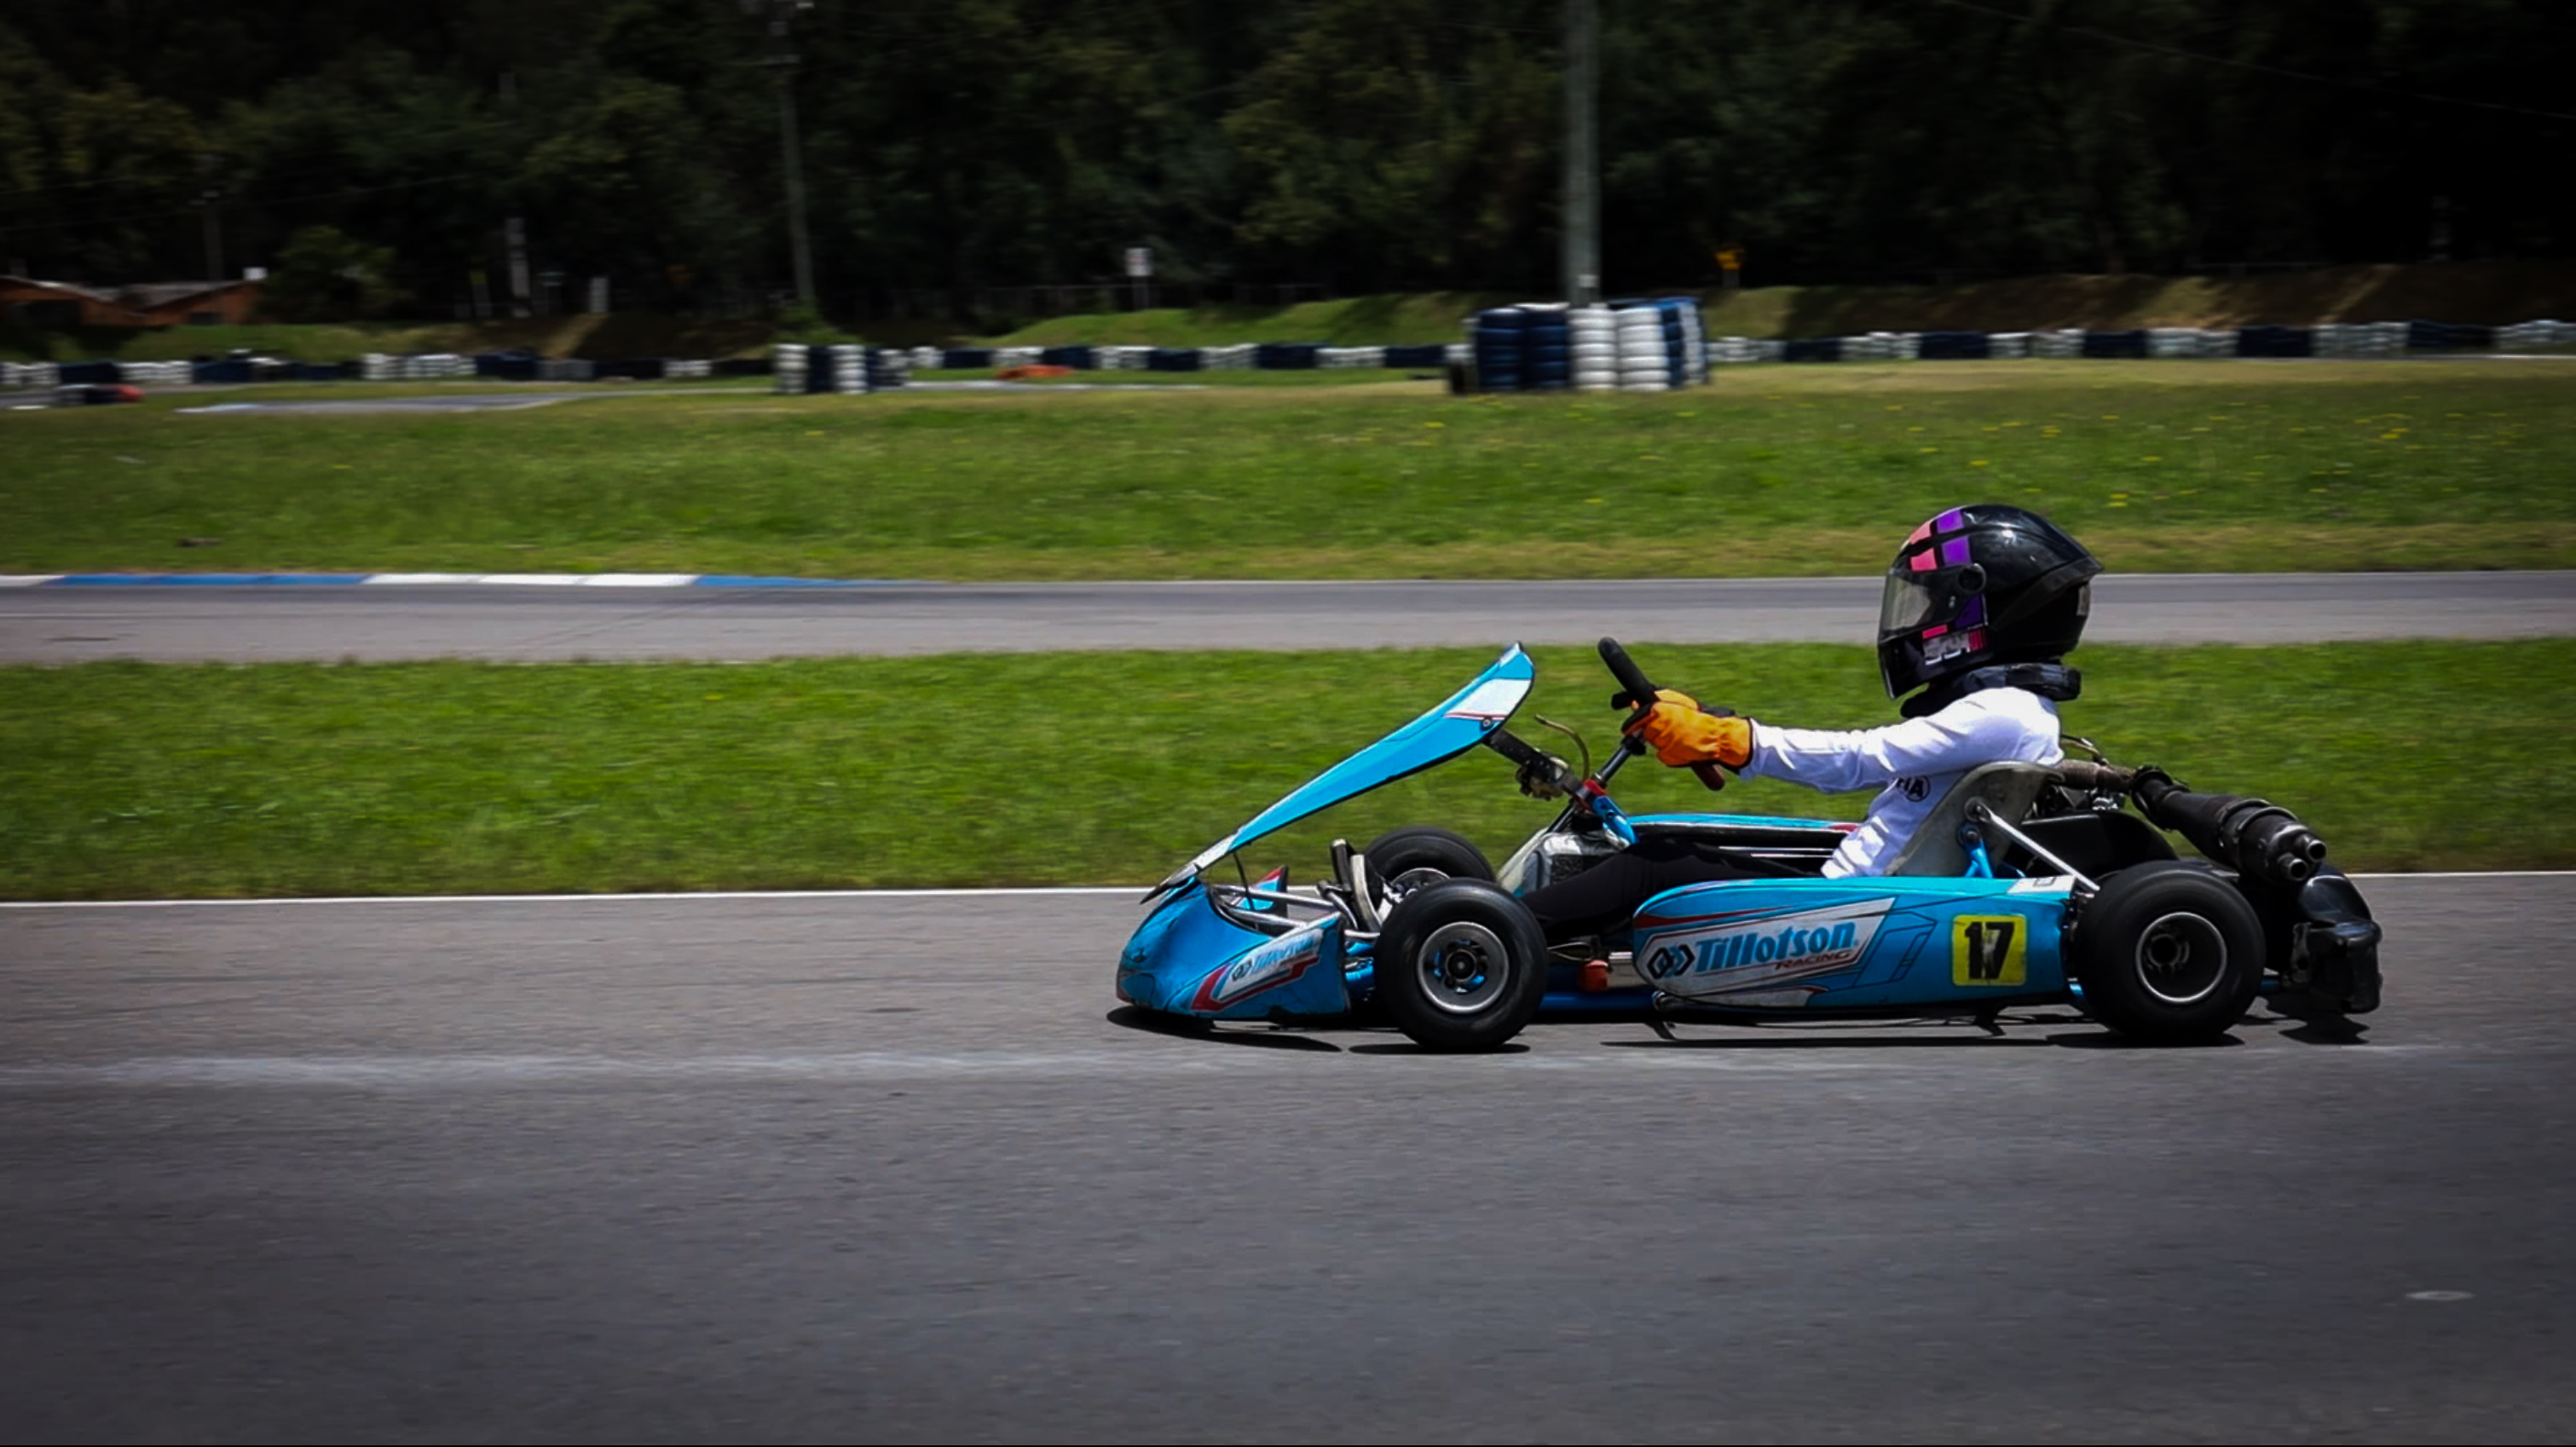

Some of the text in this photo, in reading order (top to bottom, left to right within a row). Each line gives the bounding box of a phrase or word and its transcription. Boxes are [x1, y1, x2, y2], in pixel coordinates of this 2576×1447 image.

[1695, 922, 1855, 972] Tillotson
[1775, 948, 1853, 970] RACING
[1964, 921, 2015, 979] 17
